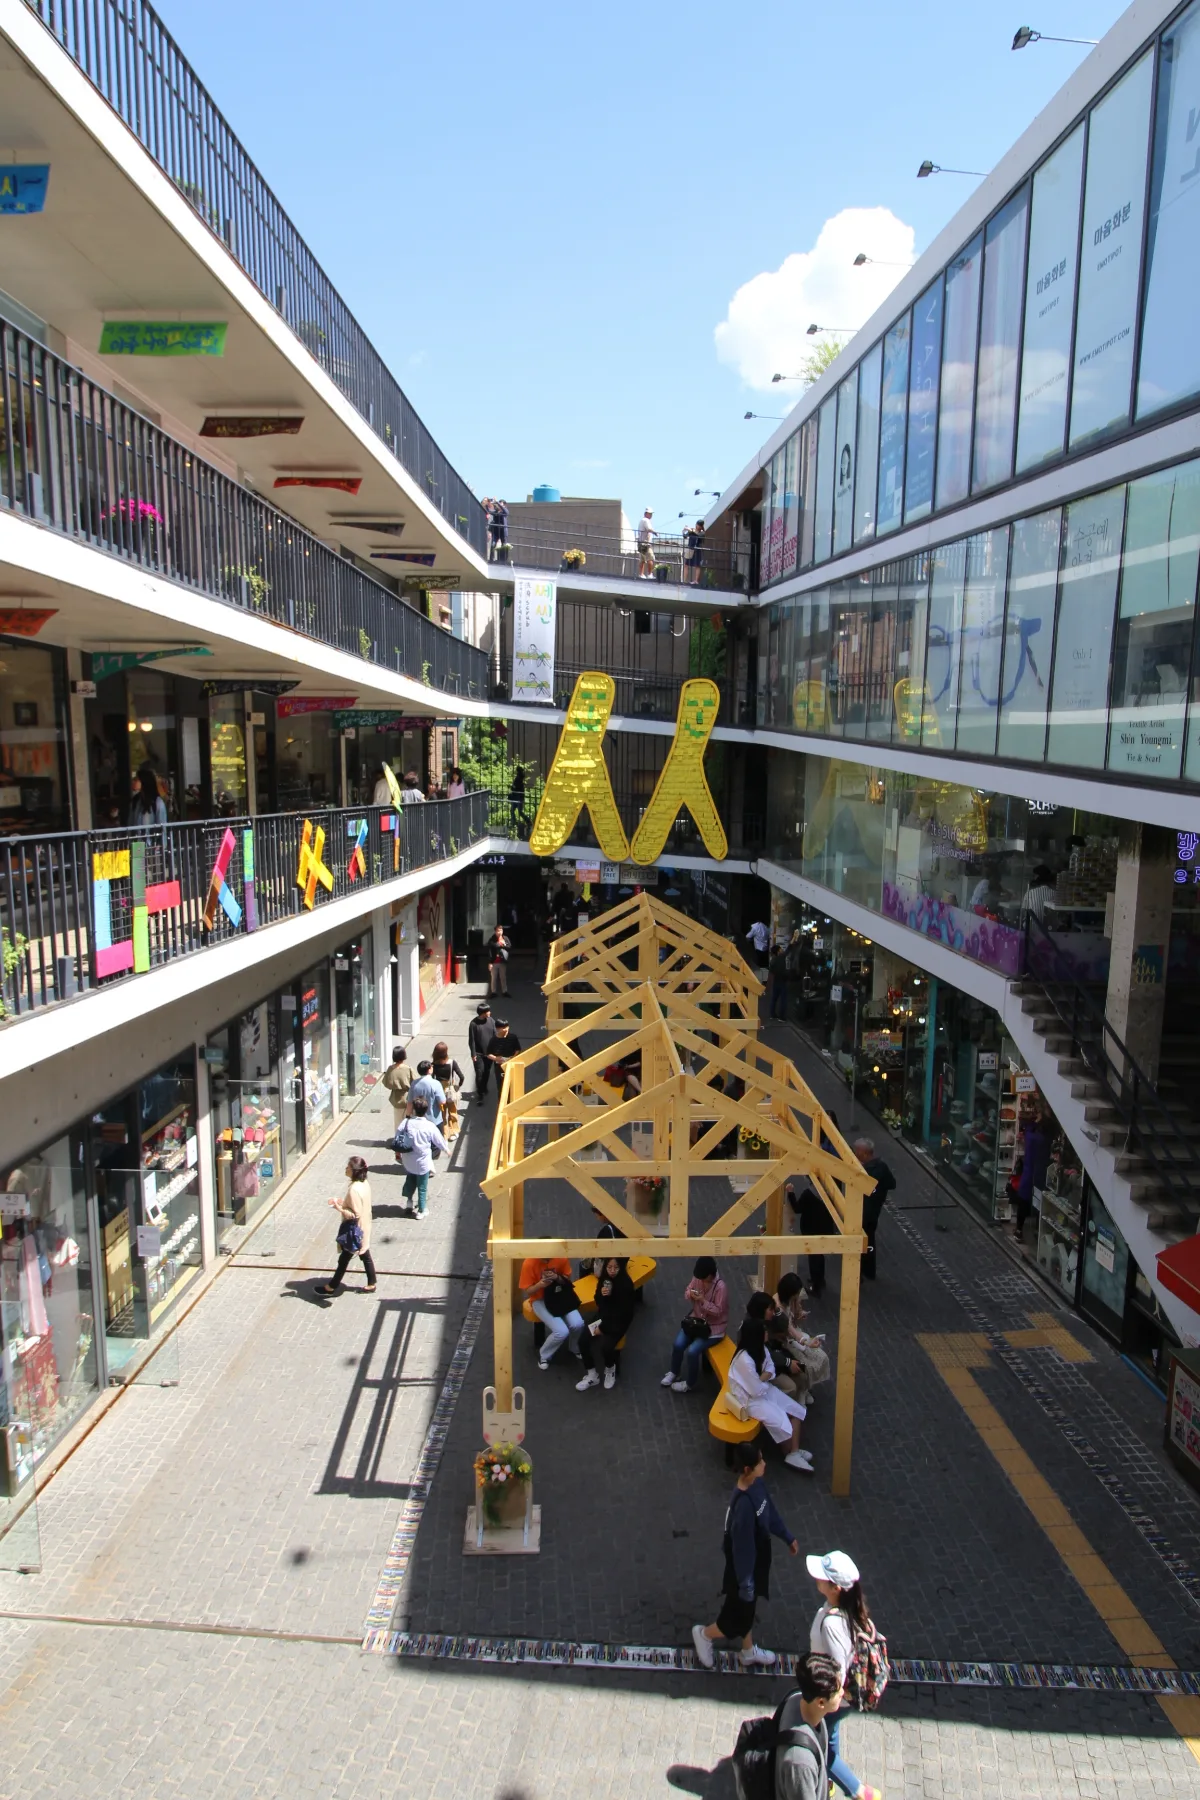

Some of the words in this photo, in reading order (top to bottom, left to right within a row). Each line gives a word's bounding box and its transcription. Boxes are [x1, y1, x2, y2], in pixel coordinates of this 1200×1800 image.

[1094, 201, 1131, 246] 마음화분
[1097, 245, 1123, 271] EMOTIPOT
[1036, 257, 1067, 295] 마음화분
[1129, 720, 1147, 728] Textile
[1149, 720, 1165, 728] Artist
[1120, 733, 1135, 744] Shin
[1140, 733, 1172, 746] Youngmi
[1144, 754, 1162, 763] Scarf
[487, 855, 506, 865] 사주
